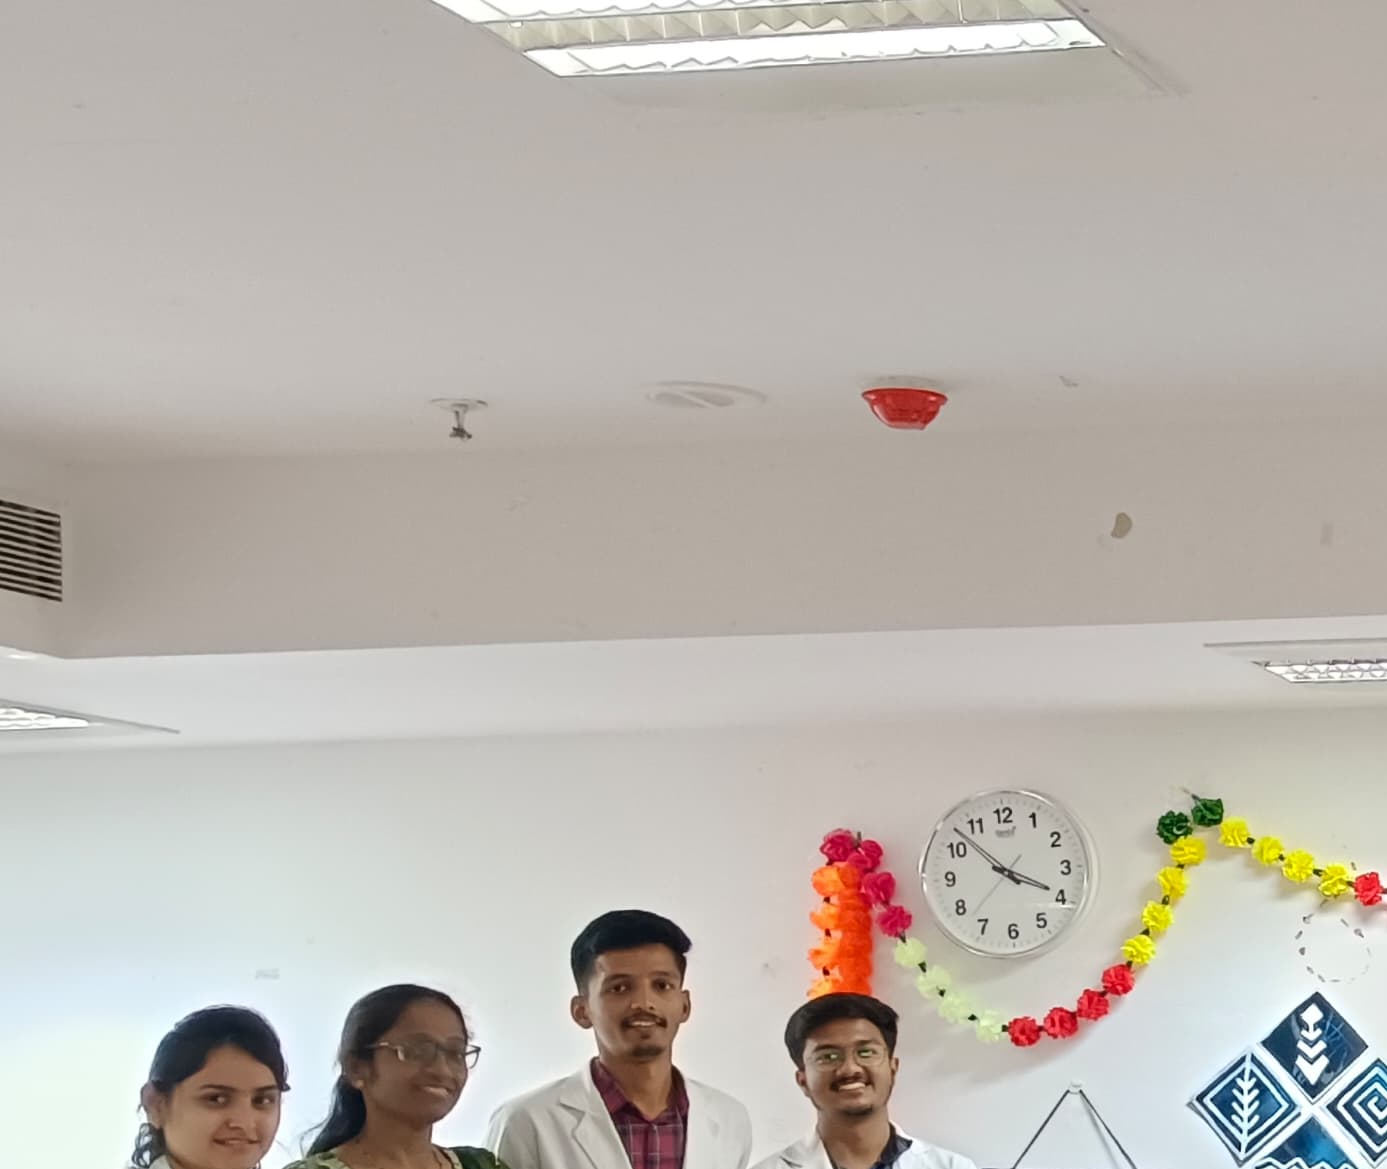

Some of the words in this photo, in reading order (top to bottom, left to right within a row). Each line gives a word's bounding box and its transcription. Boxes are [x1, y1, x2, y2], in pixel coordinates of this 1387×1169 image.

[993, 807, 1013, 824] 12
[1029, 812, 1037, 828] 1
[967, 818, 984, 834] 11
[1050, 831, 1061, 848] 2
[947, 842, 967, 859] 10
[1060, 859, 1072, 875] 3
[944, 871, 956, 888] 9
[1055, 889, 1067, 905] 4
[955, 899, 967, 916] 8
[977, 918, 989, 935] 7
[1036, 912, 1047, 929] 5
[1008, 923, 1019, 939] 6
